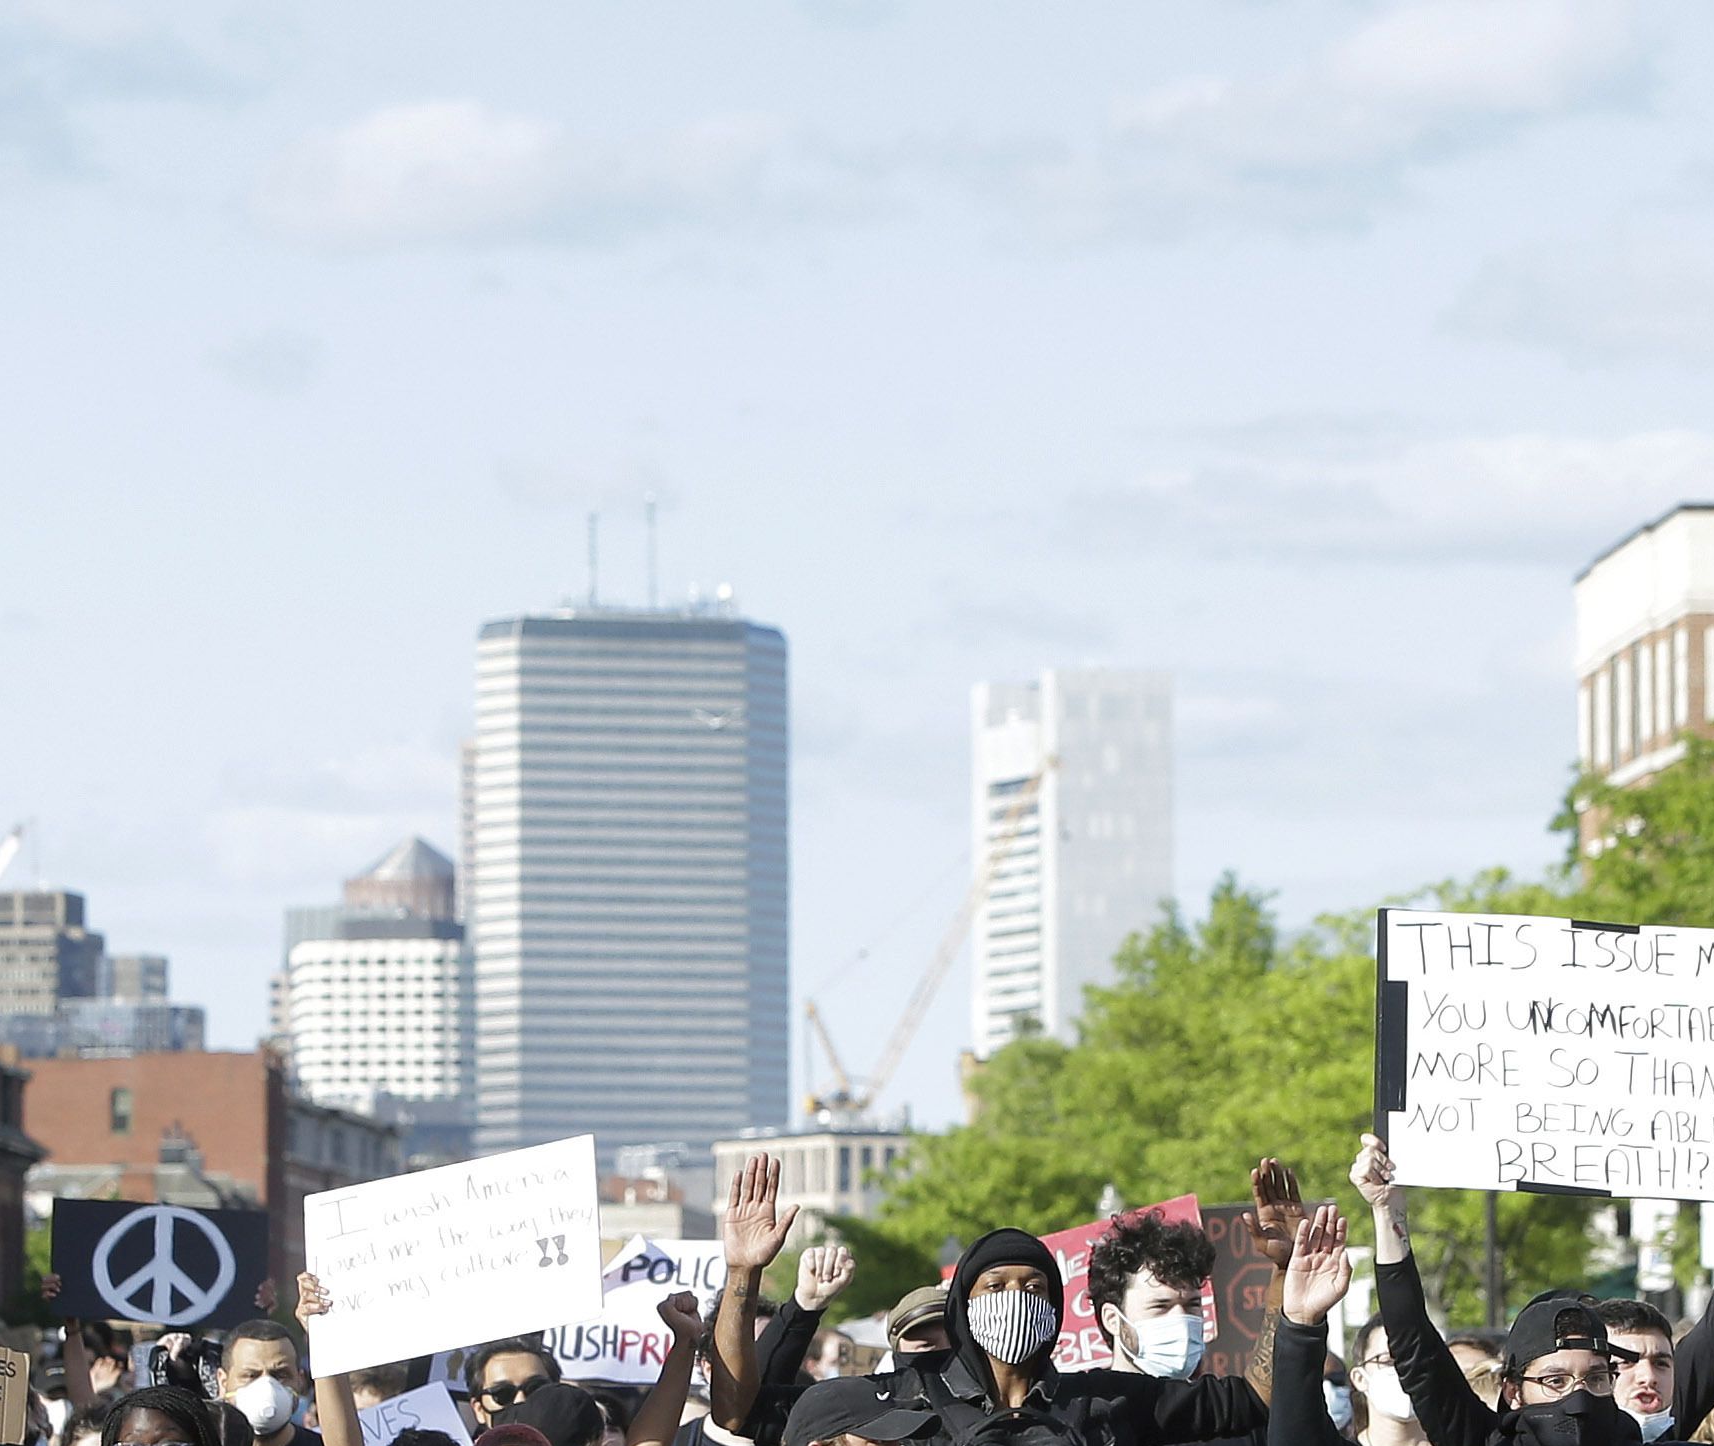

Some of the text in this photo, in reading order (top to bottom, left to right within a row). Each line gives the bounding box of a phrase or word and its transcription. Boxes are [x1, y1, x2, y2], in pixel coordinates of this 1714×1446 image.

[1396, 922, 1537, 976] THIS
[1560, 928, 1678, 977] ISSUE
[1422, 990, 1487, 1033] YOU
[1412, 1042, 1520, 1088] MORE
[1547, 1048, 1600, 1089] SO
[1407, 1097, 1482, 1133] NOT
[1516, 1102, 1634, 1137] BEING
[319, 1170, 570, 1240] I wish America
[621, 1254, 720, 1291] POLIC
[358, 1399, 422, 1440] VES
